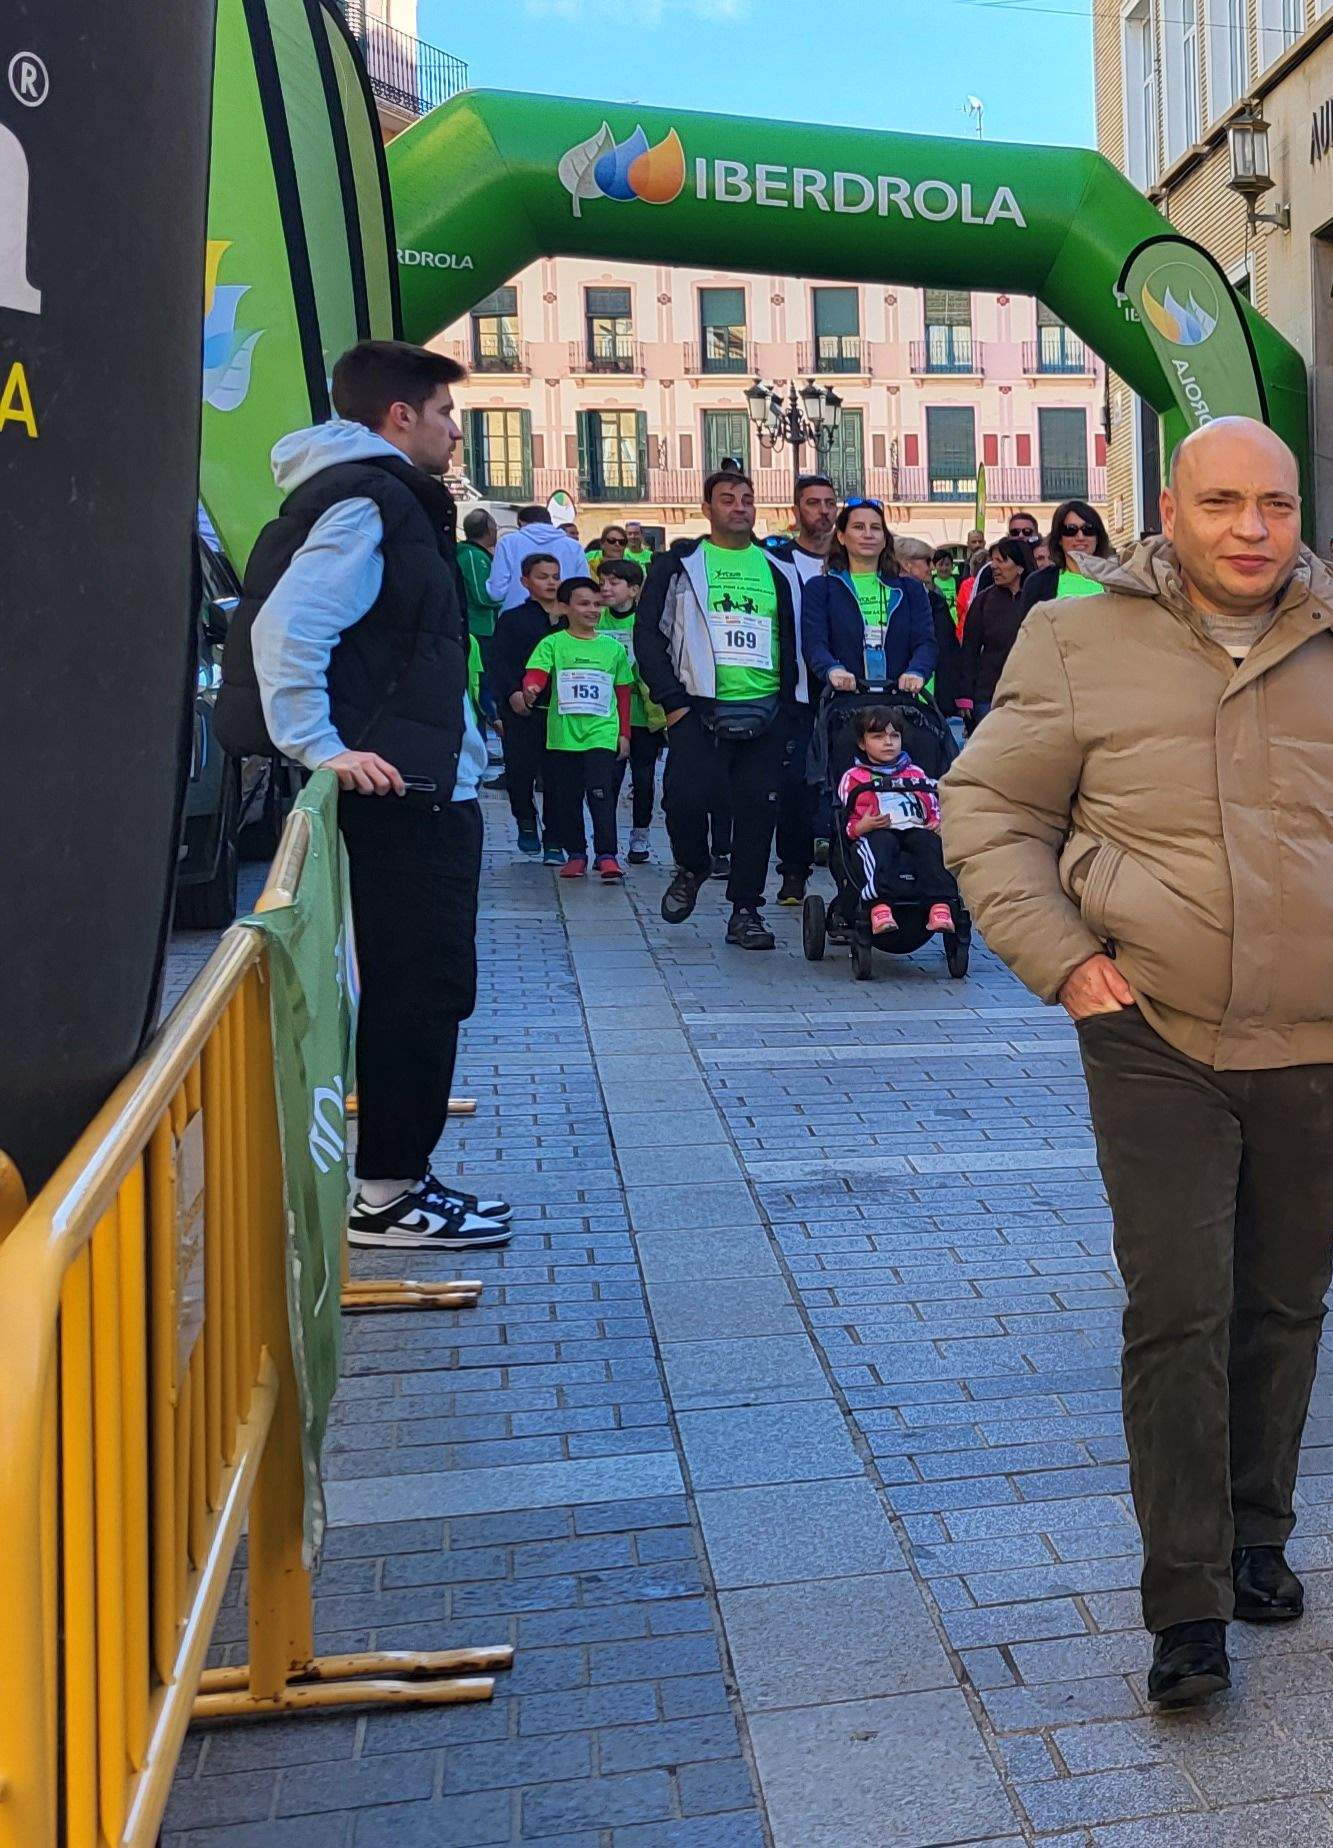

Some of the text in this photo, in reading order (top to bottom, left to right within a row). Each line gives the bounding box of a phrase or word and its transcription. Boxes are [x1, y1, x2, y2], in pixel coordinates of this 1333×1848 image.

[695, 157, 1027, 228] IBERDROLA
[724, 630, 757, 649] 169
[572, 684, 599, 699] 153
